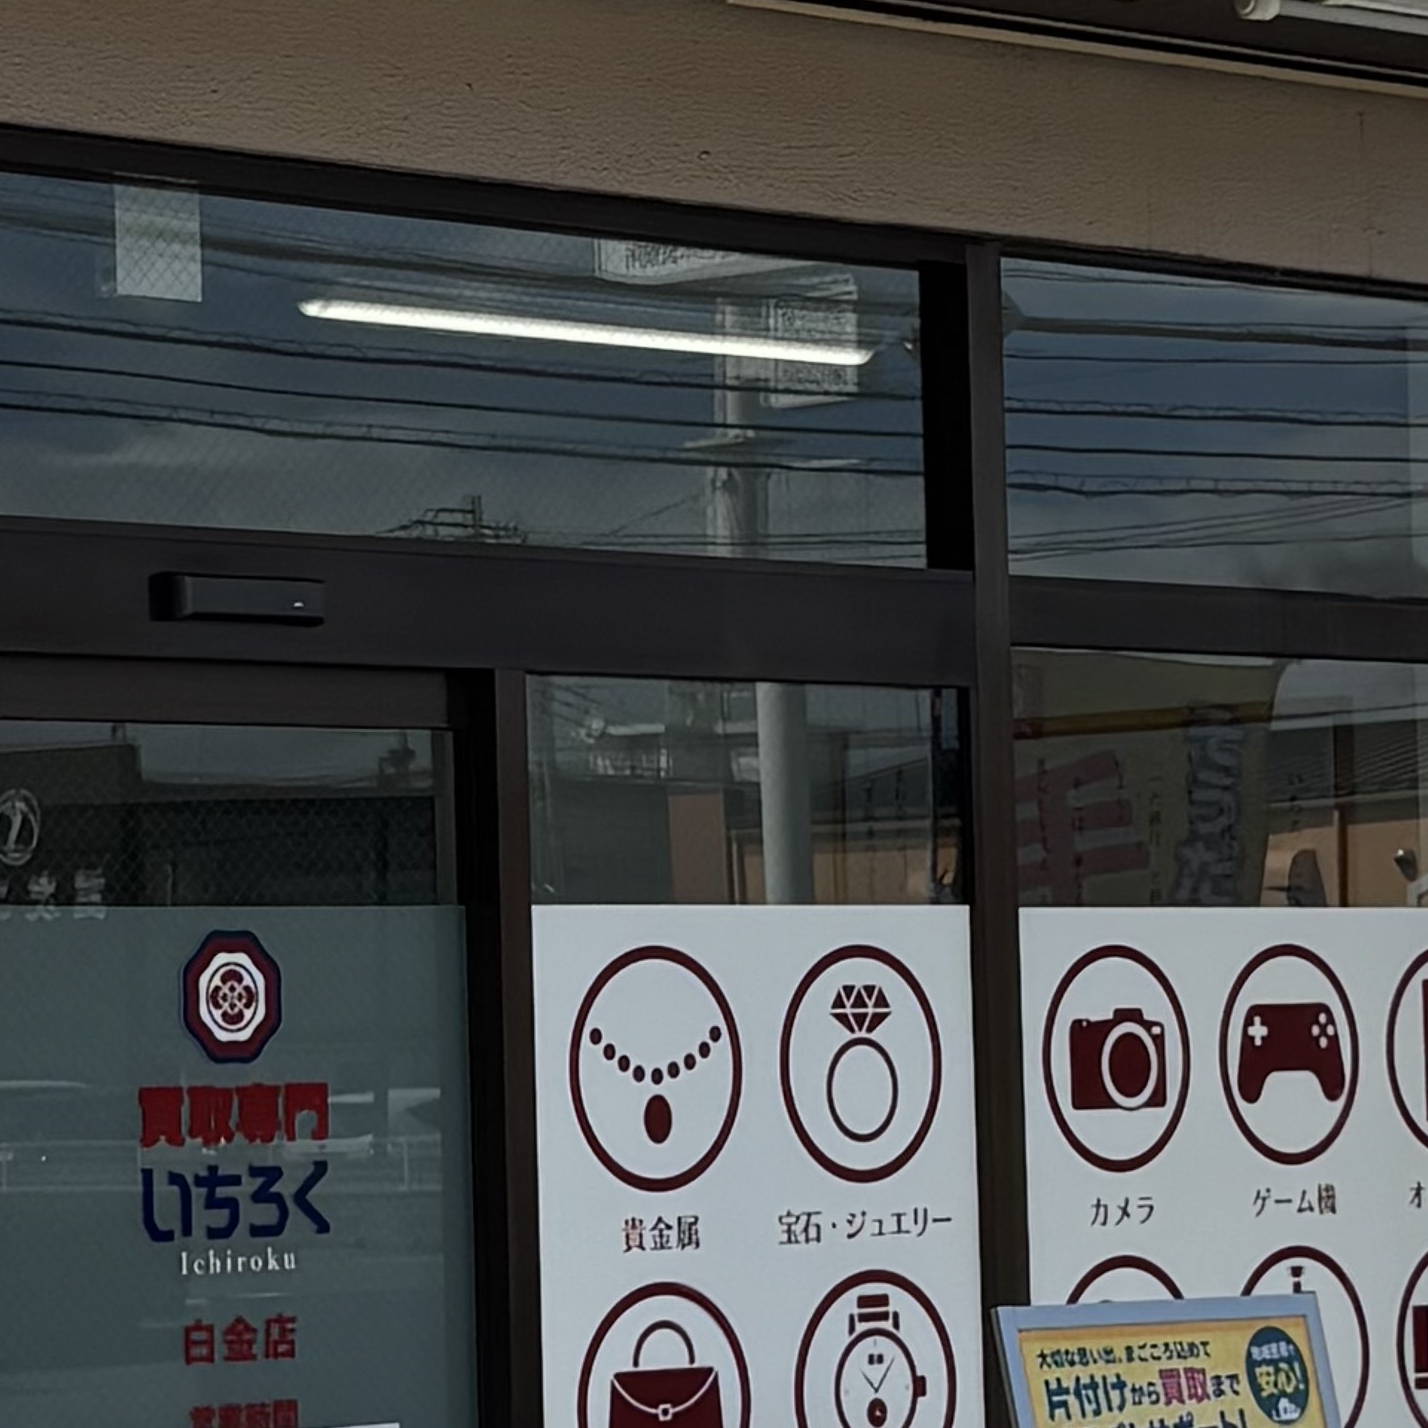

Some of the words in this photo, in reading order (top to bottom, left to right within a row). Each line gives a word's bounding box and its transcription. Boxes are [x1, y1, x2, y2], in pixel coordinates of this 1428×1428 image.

[138, 1083, 330, 1149] 買取専門
[139, 1160, 331, 1243] いちろく
[1089, 1196, 1156, 1228] カメラ
[1252, 1183, 1338, 1218] ゲーム機
[621, 1215, 701, 1253] 貴金属
[777, 1207, 953, 1246] 宝石・ジュエリー
[180, 1247, 298, 1276] Ichiroku
[183, 1314, 298, 1366] 白金店
[1044, 1365, 1241, 1424] 片付けから買取まで
[1255, 1362, 1306, 1398] 安心!
